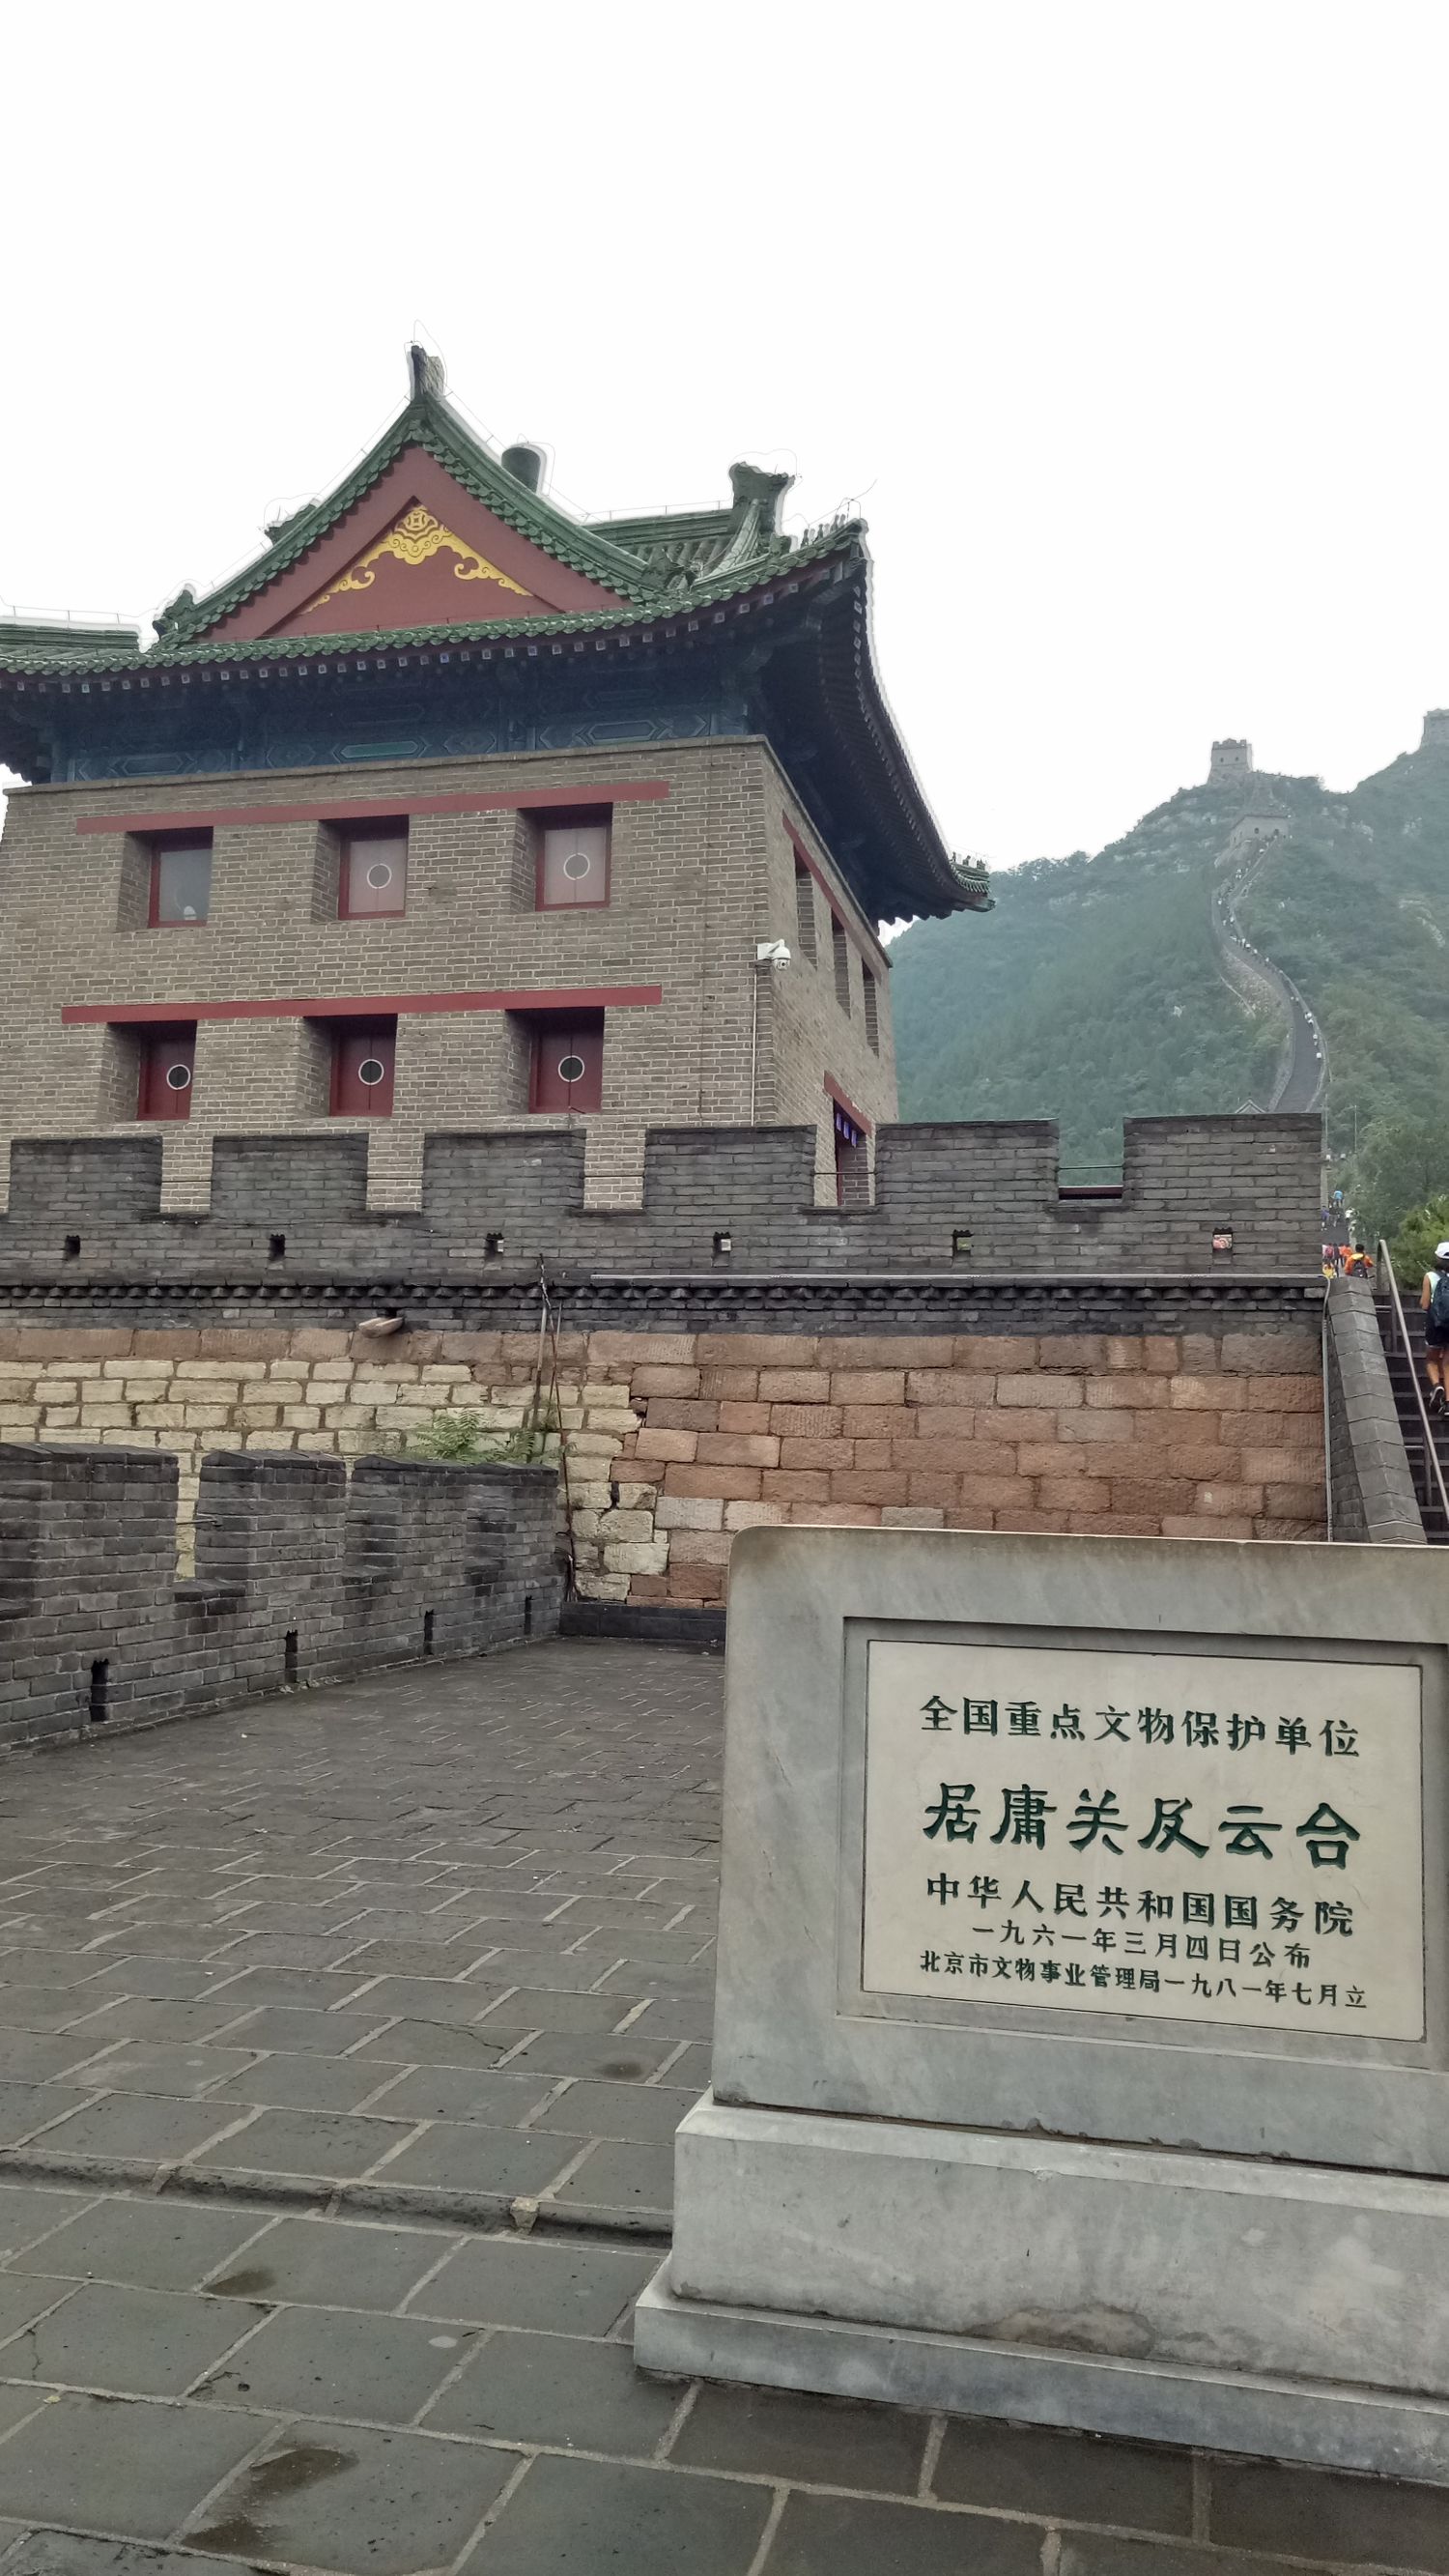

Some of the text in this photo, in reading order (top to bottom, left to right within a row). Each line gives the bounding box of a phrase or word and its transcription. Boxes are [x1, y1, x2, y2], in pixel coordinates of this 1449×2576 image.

[920, 1695, 1360, 1758] 全国重点文物保护单位
[926, 1873, 1353, 1937] 中华人民共和国国务院
[972, 1919, 1312, 1969] 一九六一年三月四日公布
[920, 1950, 1368, 2009] 北京市文物事业管理局一九八一年七月立
